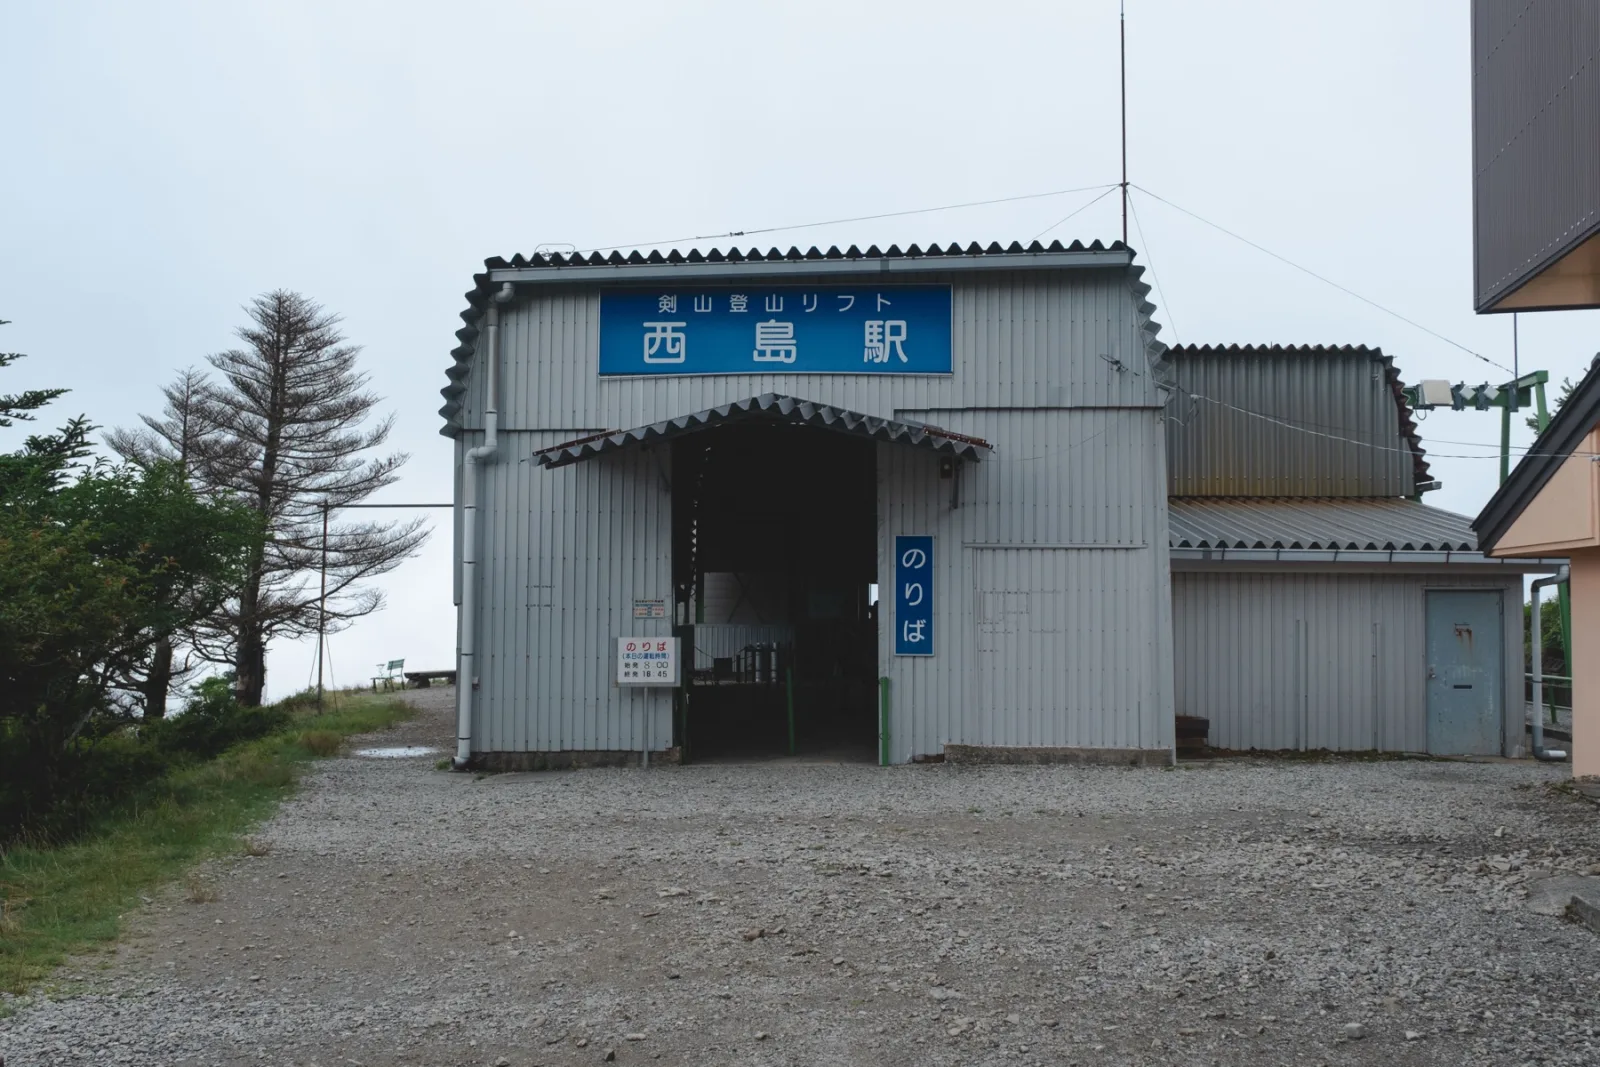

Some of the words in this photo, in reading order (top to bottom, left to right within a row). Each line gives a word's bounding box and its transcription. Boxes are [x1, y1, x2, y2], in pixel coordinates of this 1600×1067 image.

[658, 294, 892, 314] 剣山登山リフト
[643, 319, 909, 364] 西島駅
[902, 548, 927, 643] のりば
[626, 641, 667, 652] のりば
